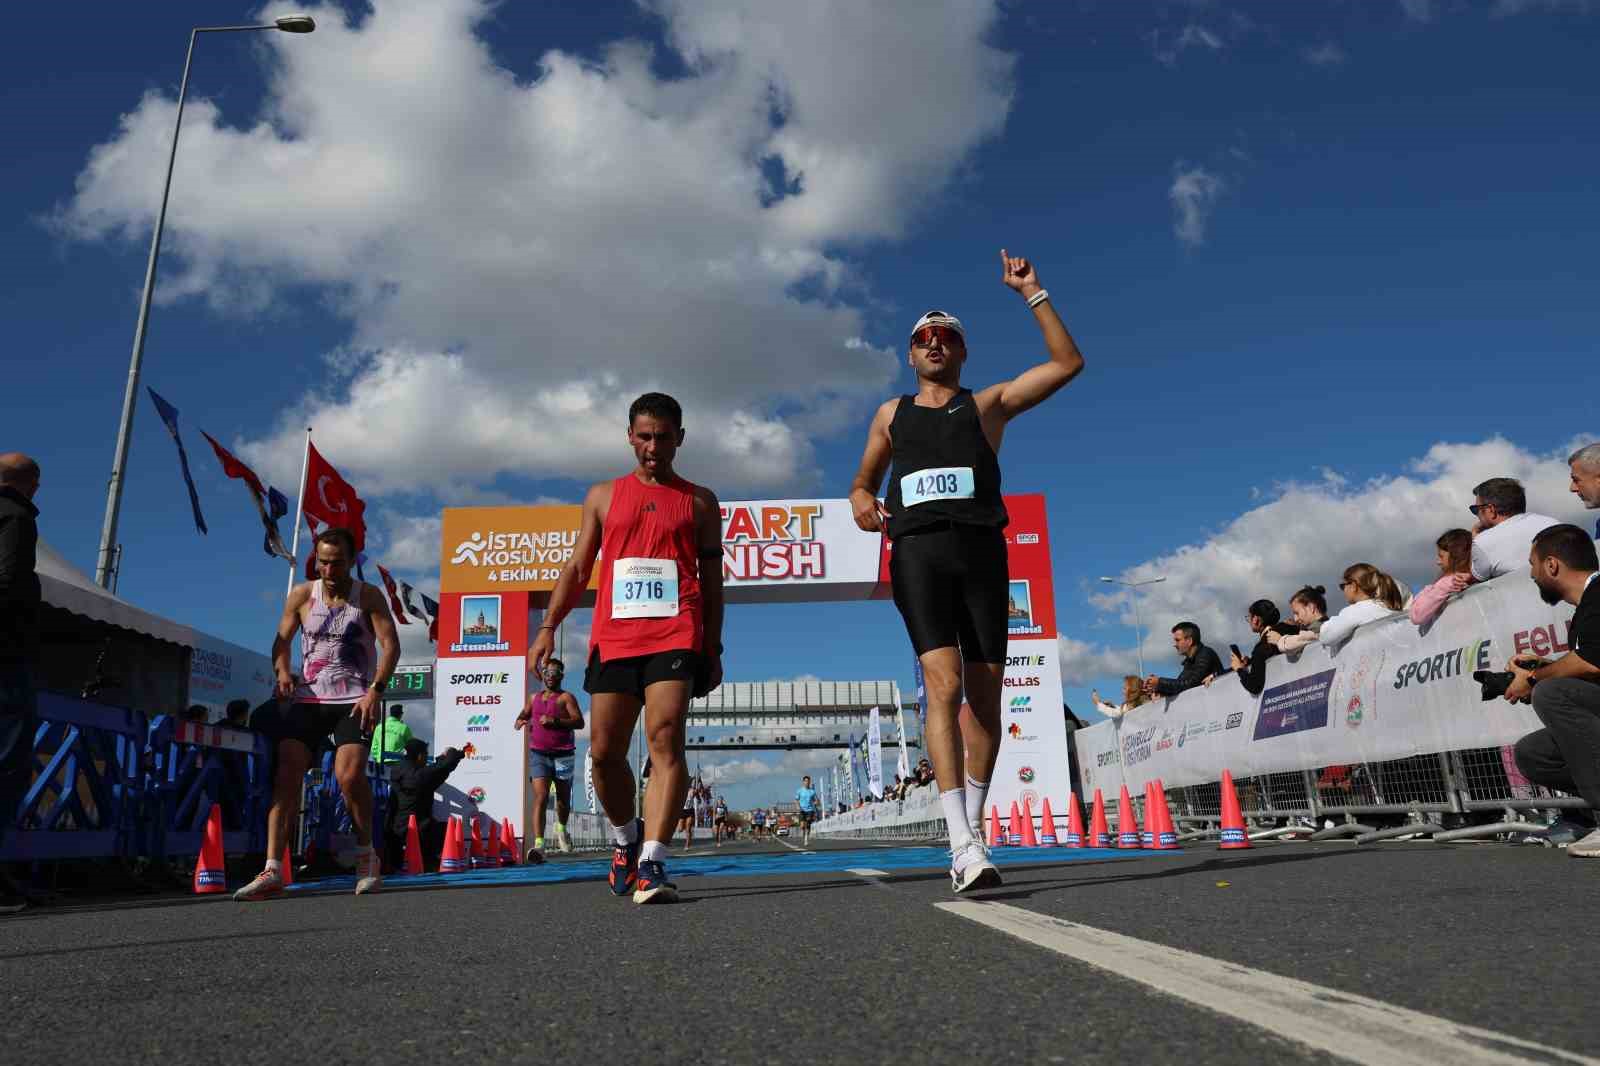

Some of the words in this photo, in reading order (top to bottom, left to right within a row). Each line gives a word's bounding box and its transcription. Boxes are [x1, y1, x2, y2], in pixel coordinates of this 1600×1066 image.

[916, 474, 957, 496] 4203
[721, 504, 822, 542] ART
[487, 530, 581, 551] İSTANBU
[482, 548, 602, 566] KOSUYOR
[721, 543, 825, 580] NISH
[487, 570, 498, 581] 4
[500, 566, 538, 581] EKİM
[541, 567, 562, 580] 20
[625, 581, 663, 600] 3716
[1004, 655, 1045, 666] ORTIVE
[1394, 639, 1491, 690] SPORTIVE
[450, 671, 509, 685] SPORTIVE
